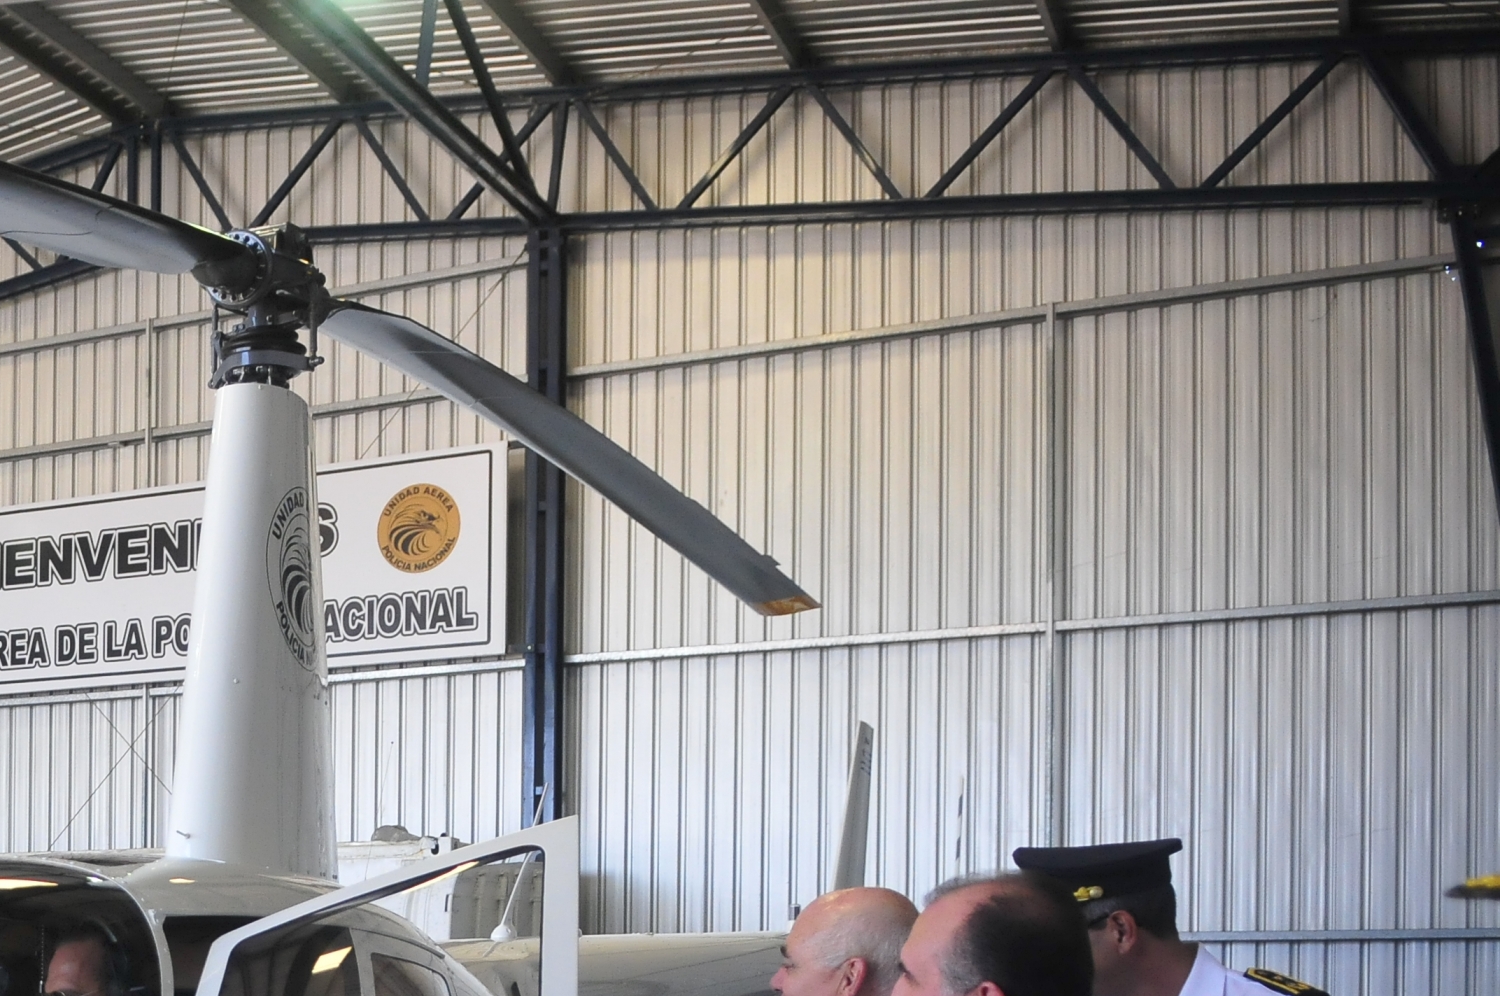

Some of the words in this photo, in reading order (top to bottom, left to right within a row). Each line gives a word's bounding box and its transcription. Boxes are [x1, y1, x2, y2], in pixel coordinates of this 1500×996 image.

[272, 491, 304, 540] UNIDAD
[383, 486, 420, 517] UNIDAD
[423, 486, 453, 513] AEREA
[382, 545, 411, 571] POLICIA
[414, 537, 456, 571] NACIONAL
[55, 621, 98, 666] DE
[103, 618, 148, 660] LA
[324, 586, 479, 643] ACIONAL
